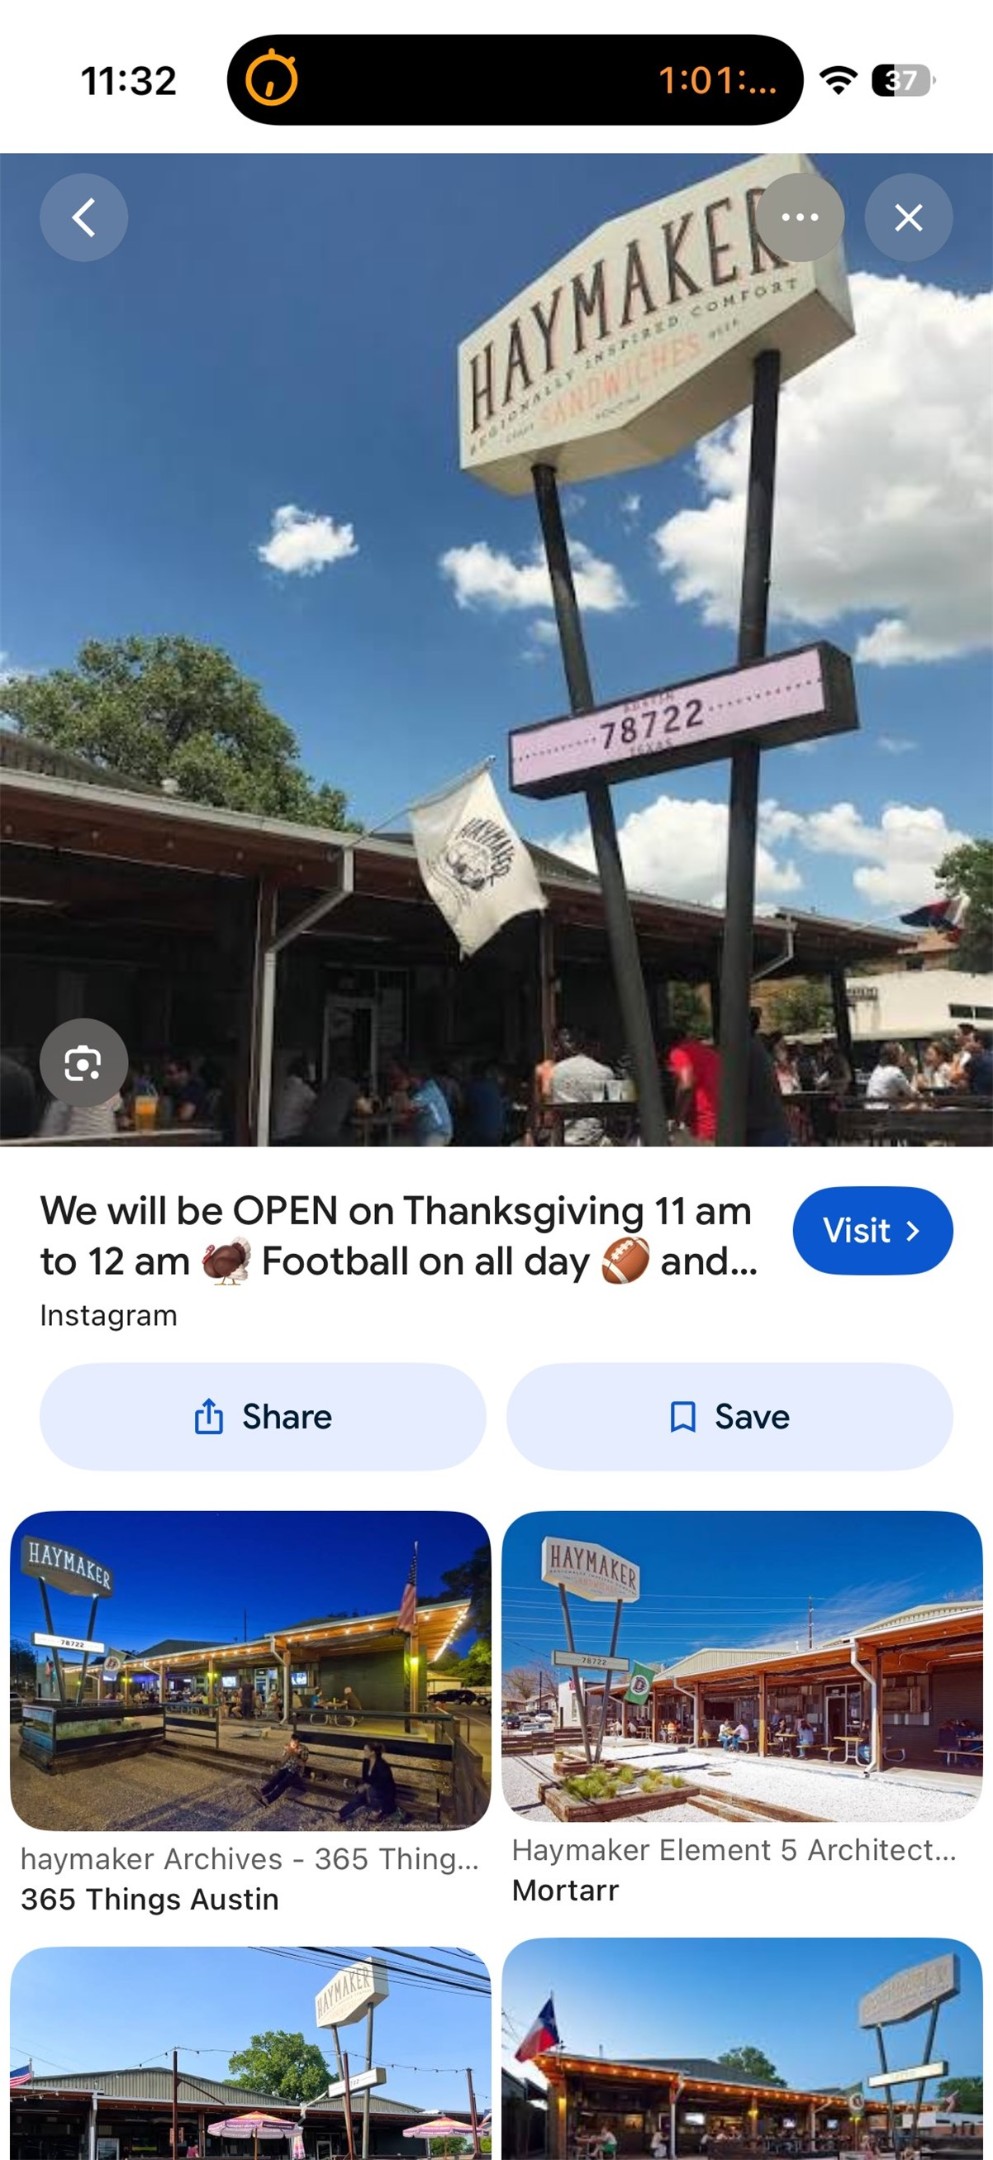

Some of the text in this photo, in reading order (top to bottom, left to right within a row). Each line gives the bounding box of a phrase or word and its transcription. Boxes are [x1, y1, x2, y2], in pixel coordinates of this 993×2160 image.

[82, 66, 177, 96] 11:32
[885, 70, 918, 91] 37
[470, 368, 575, 456] REGIONALLY
[584, 315, 679, 370] INSPIRED
[690, 277, 798, 317] COMFORT
[539, 331, 702, 431] SANDWICHES
[600, 698, 704, 750] 78722
[40, 1195, 751, 1234] We will be OPEN on Thanksgiving 11 am
[823, 1216, 891, 1243] Visit
[40, 1248, 76, 1276] to
[88, 1246, 124, 1275] 12
[135, 1253, 190, 1275] am
[263, 1246, 407, 1276] Football
[419, 1253, 463, 1276] on
[475, 1246, 512, 1275] all
[525, 1246, 590, 1283] day
[40, 1303, 178, 1332] Instagram
[243, 1402, 332, 1429] Share
[715, 1402, 791, 1429] Save
[28, 1541, 111, 1592] HAYMAKER
[550, 1544, 637, 1592] HAYMAKER
[581, 1656, 608, 1666] 78722
[21, 1847, 154, 1875] haymaker
[164, 1847, 282, 1870] Archives
[315, 1847, 368, 1870] 365
[513, 1838, 650, 1866] Haymaker
[661, 1838, 770, 1861] Element
[781, 1838, 797, 1861] 5
[21, 1886, 279, 1915] 365 Things Austin
[513, 1878, 620, 1902] Mortarr
[317, 1966, 371, 2020] HAYMAKER
